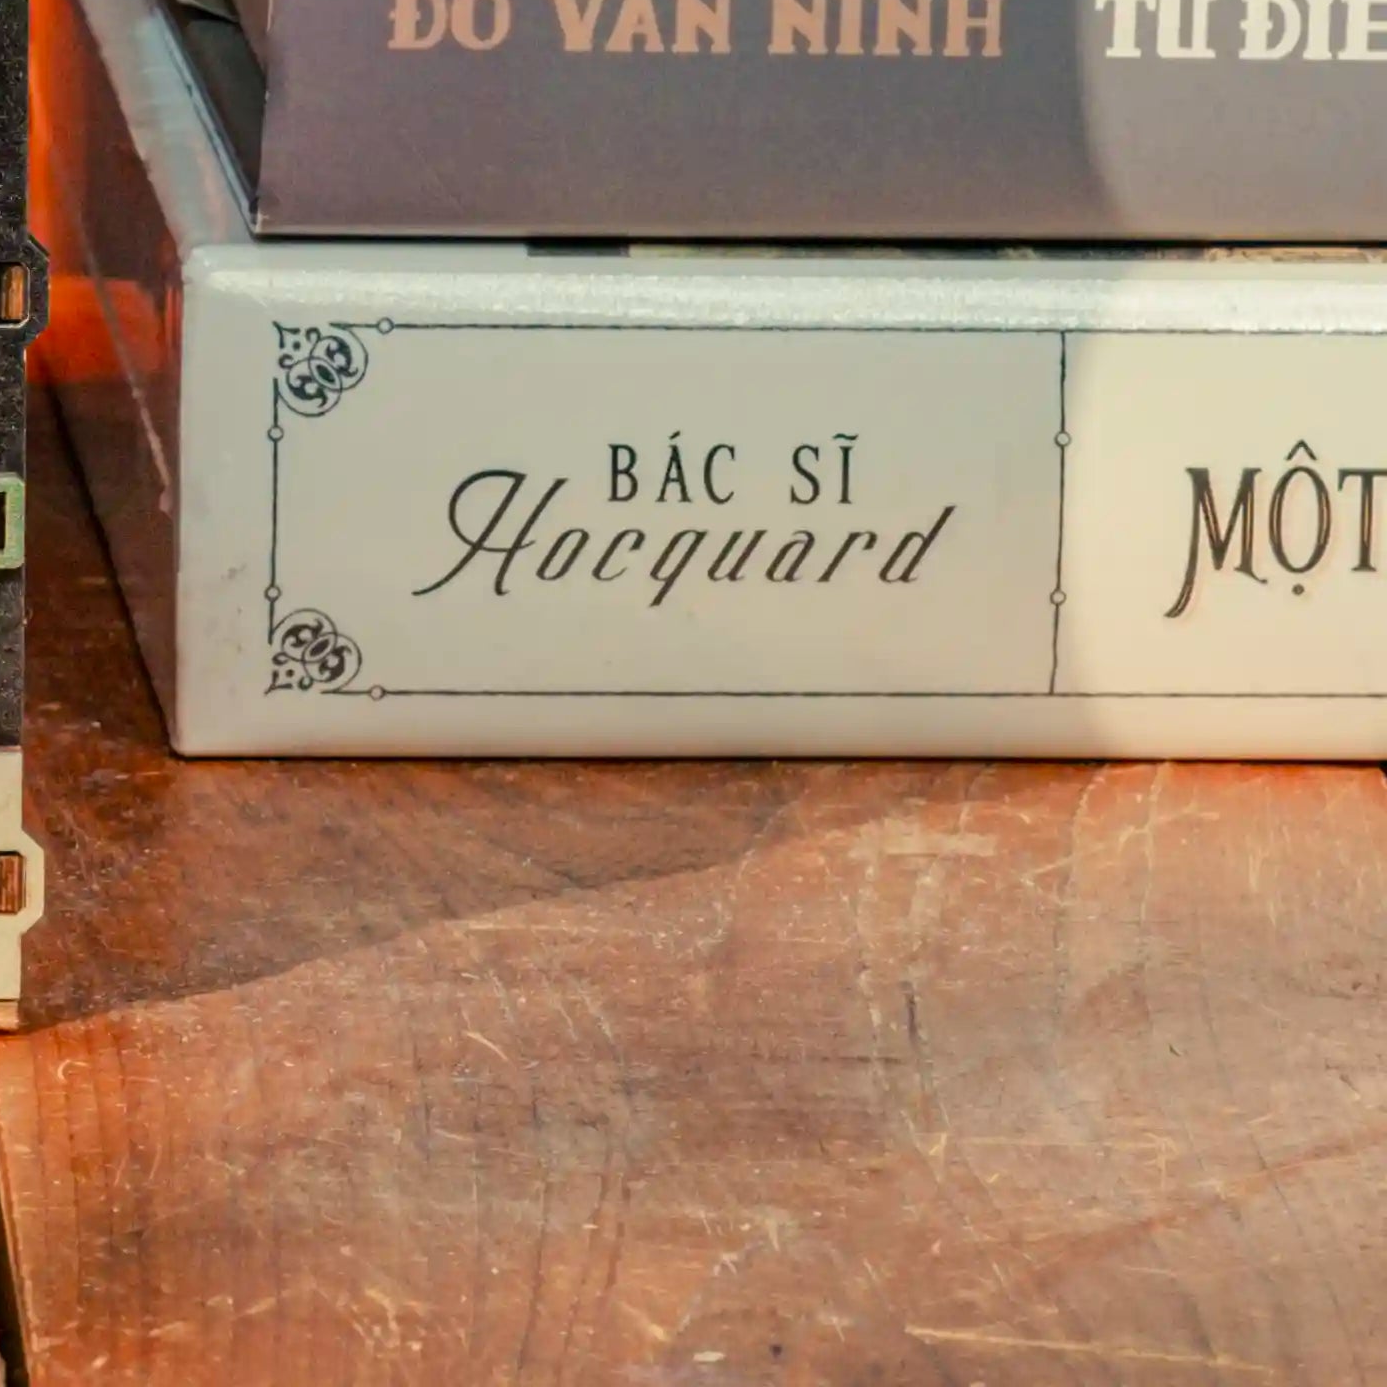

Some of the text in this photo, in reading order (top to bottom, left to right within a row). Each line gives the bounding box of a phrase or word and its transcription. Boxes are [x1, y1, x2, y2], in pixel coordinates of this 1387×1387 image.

[606, 429, 860, 506] BÁC SĨ
[410, 468, 958, 608] Hocquard
